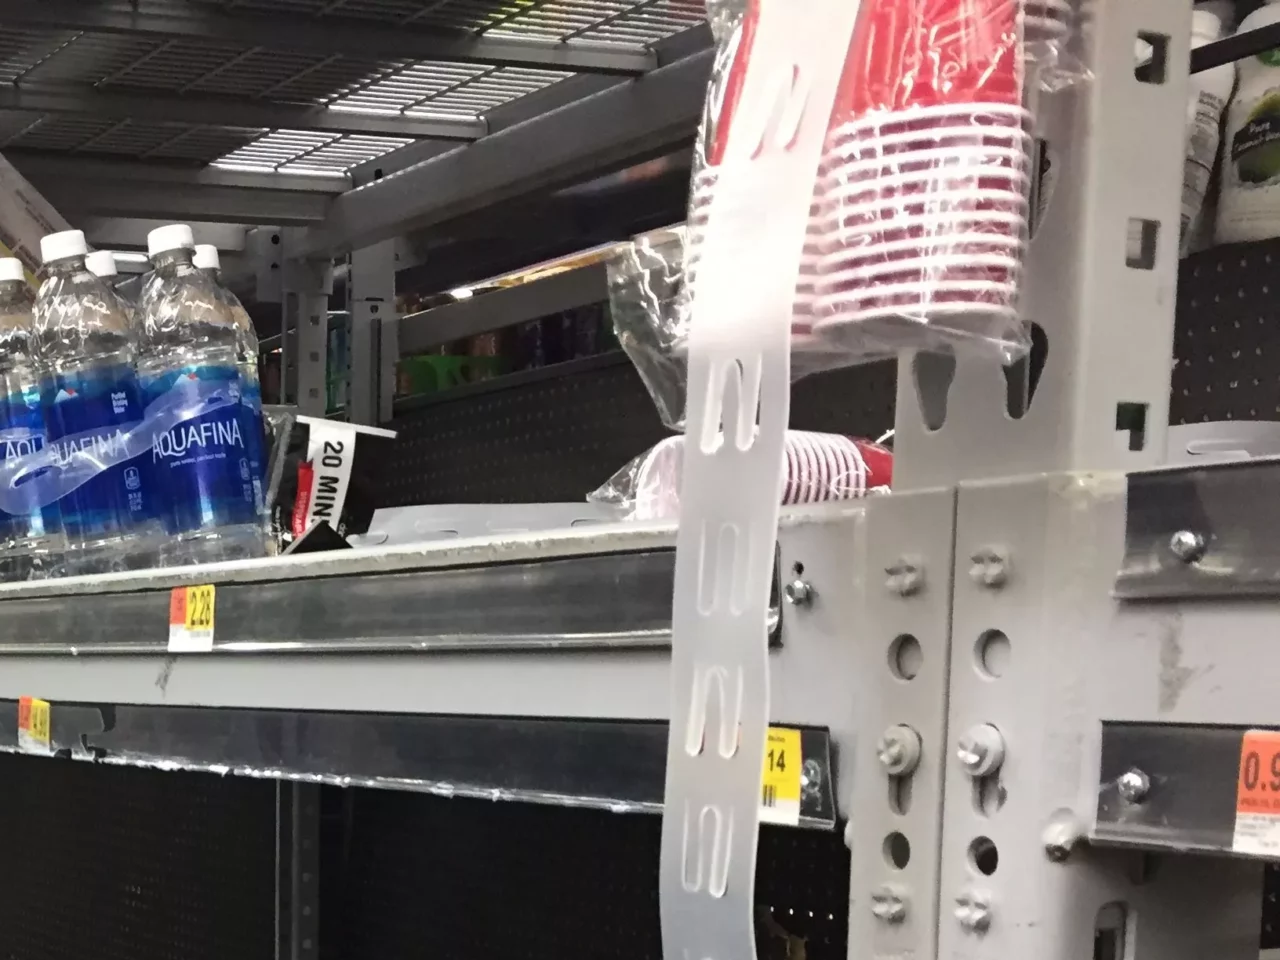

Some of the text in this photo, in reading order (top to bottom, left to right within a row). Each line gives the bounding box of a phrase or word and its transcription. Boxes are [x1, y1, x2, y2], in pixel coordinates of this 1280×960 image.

[151, 418, 245, 464] AQUAFINA
[311, 441, 344, 522] 20 MIN
[767, 749, 786, 772] 14
[1244, 752, 1280, 791] 0.9
